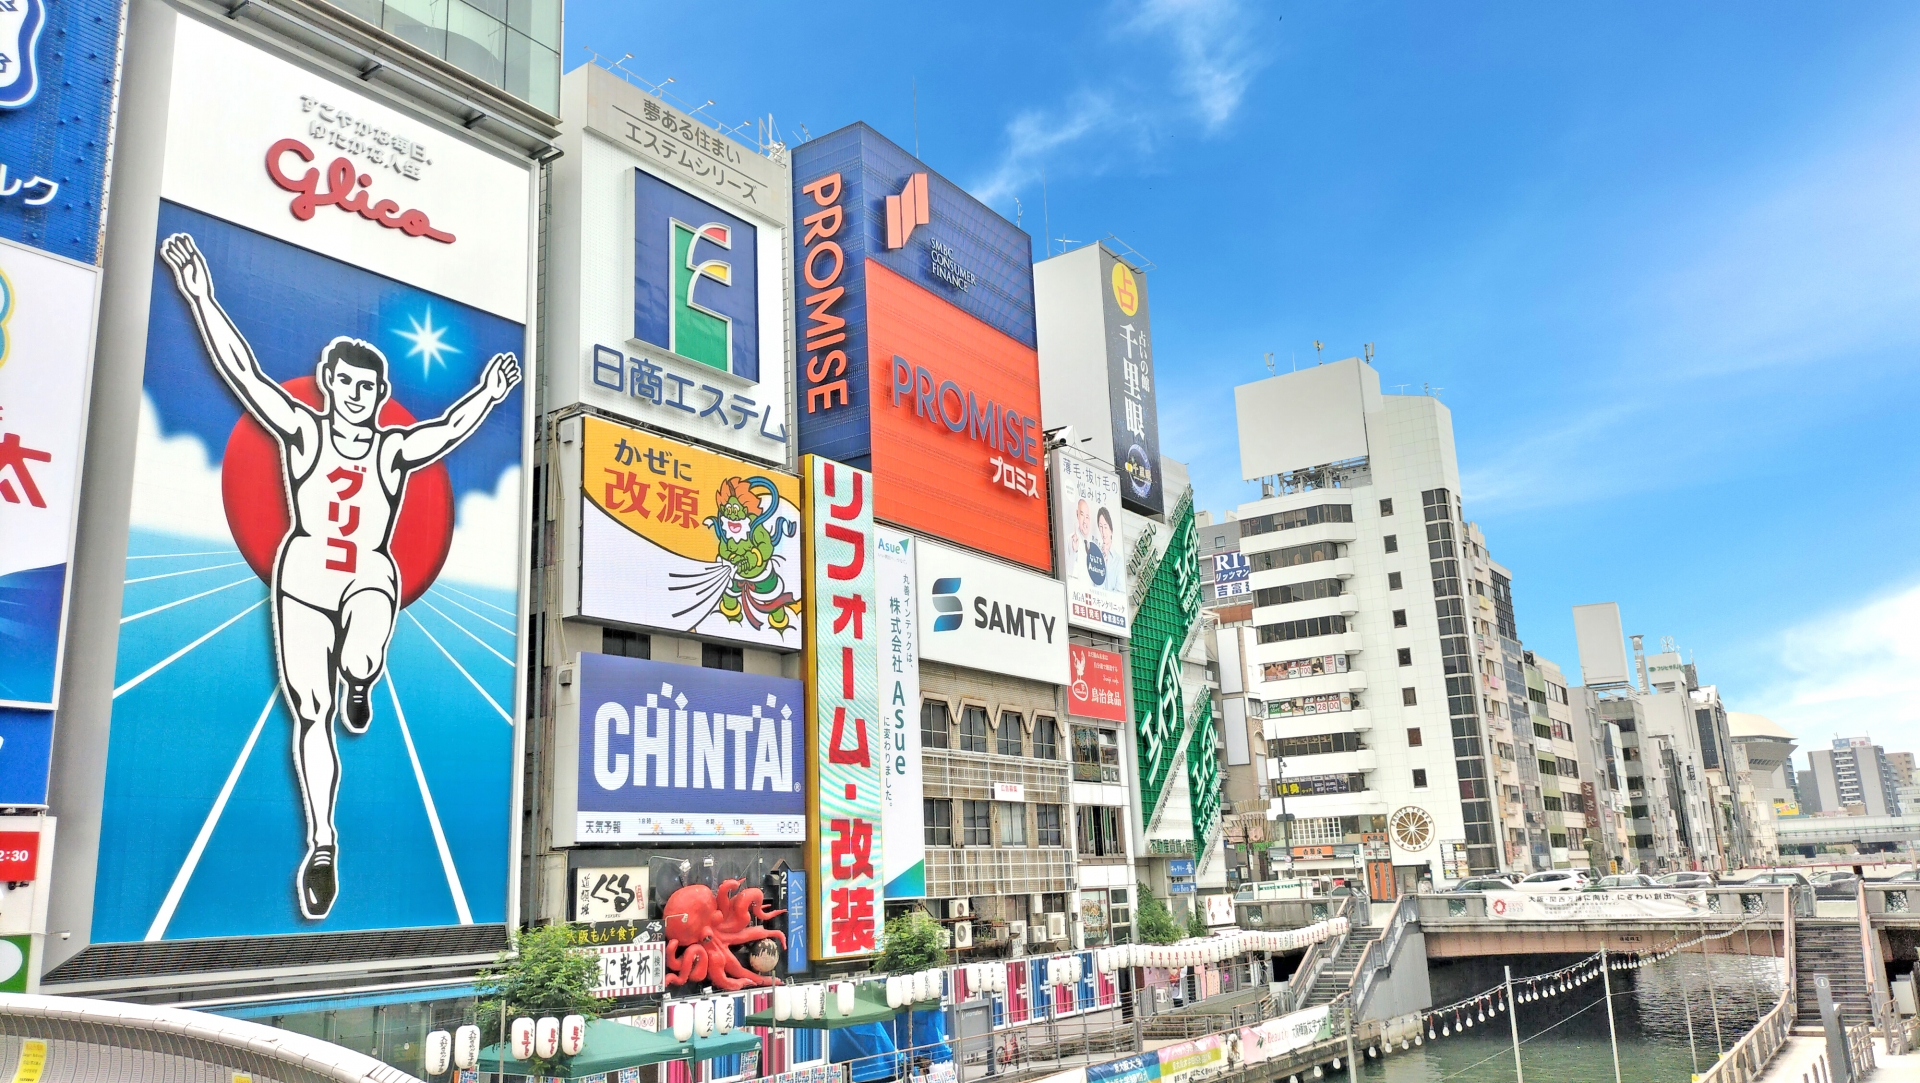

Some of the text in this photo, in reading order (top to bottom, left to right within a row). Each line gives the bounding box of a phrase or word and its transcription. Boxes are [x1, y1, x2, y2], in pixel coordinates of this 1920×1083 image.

[300, 94, 434, 167] すこやかな毎日、
[308, 119, 421, 182] ゆたかな人生
[643, 98, 741, 165] 夢ある住まい
[265, 138, 457, 244] Glico
[625, 121, 757, 204] エステムシリーズ
[930, 237, 954, 261] SMBC
[930, 249, 976, 287] CONSUMER
[931, 260, 969, 294] FINANCE
[802, 172, 848, 414] PROMISE
[1117, 265, 1135, 312] 占
[593, 343, 787, 443] 日商エステム
[1119, 323, 1146, 441] 千里眼
[1138, 330, 1150, 393] 占いの館
[892, 353, 1038, 467] PROMISE
[614, 438, 693, 482] かぜに
[989, 455, 1041, 500] プロミス
[326, 464, 368, 574] グリコ
[603, 467, 700, 530] 改源
[877, 538, 901, 555] Asue
[974, 595, 1056, 644] SAMTY
[889, 596, 906, 775] 株式会社 Asue
[1140, 652, 1184, 763] エイブル
[594, 682, 793, 792] CHINTAI
[883, 715, 893, 807] に変わりました。
[585, 820, 621, 834] 天気予報
[591, 873, 636, 914] くくる
[780, 871, 788, 900] 2F
[651, 932, 663, 942] 2F
[790, 879, 805, 963] ペンギンバー
